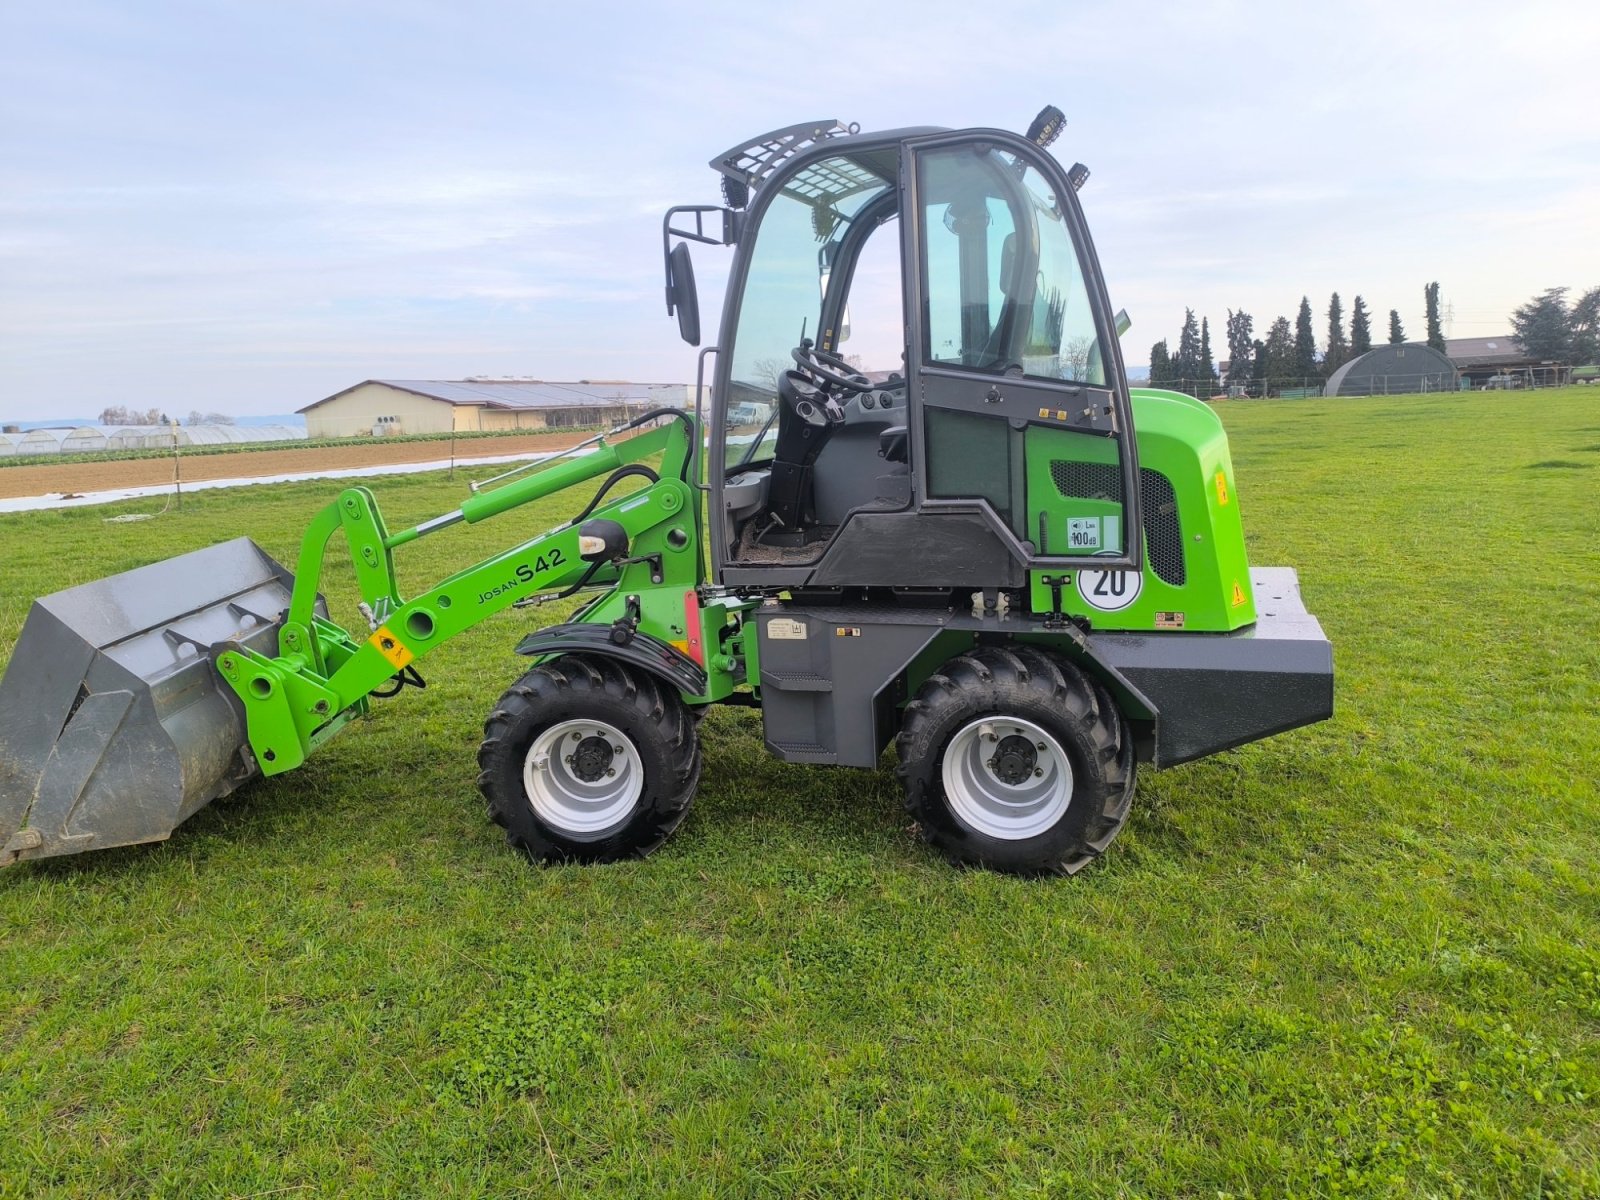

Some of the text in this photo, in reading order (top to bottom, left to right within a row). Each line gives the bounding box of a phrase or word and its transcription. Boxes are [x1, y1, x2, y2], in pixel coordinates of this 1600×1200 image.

[478, 548, 567, 604] JOSAN S42
[1093, 570, 1126, 596] 20
